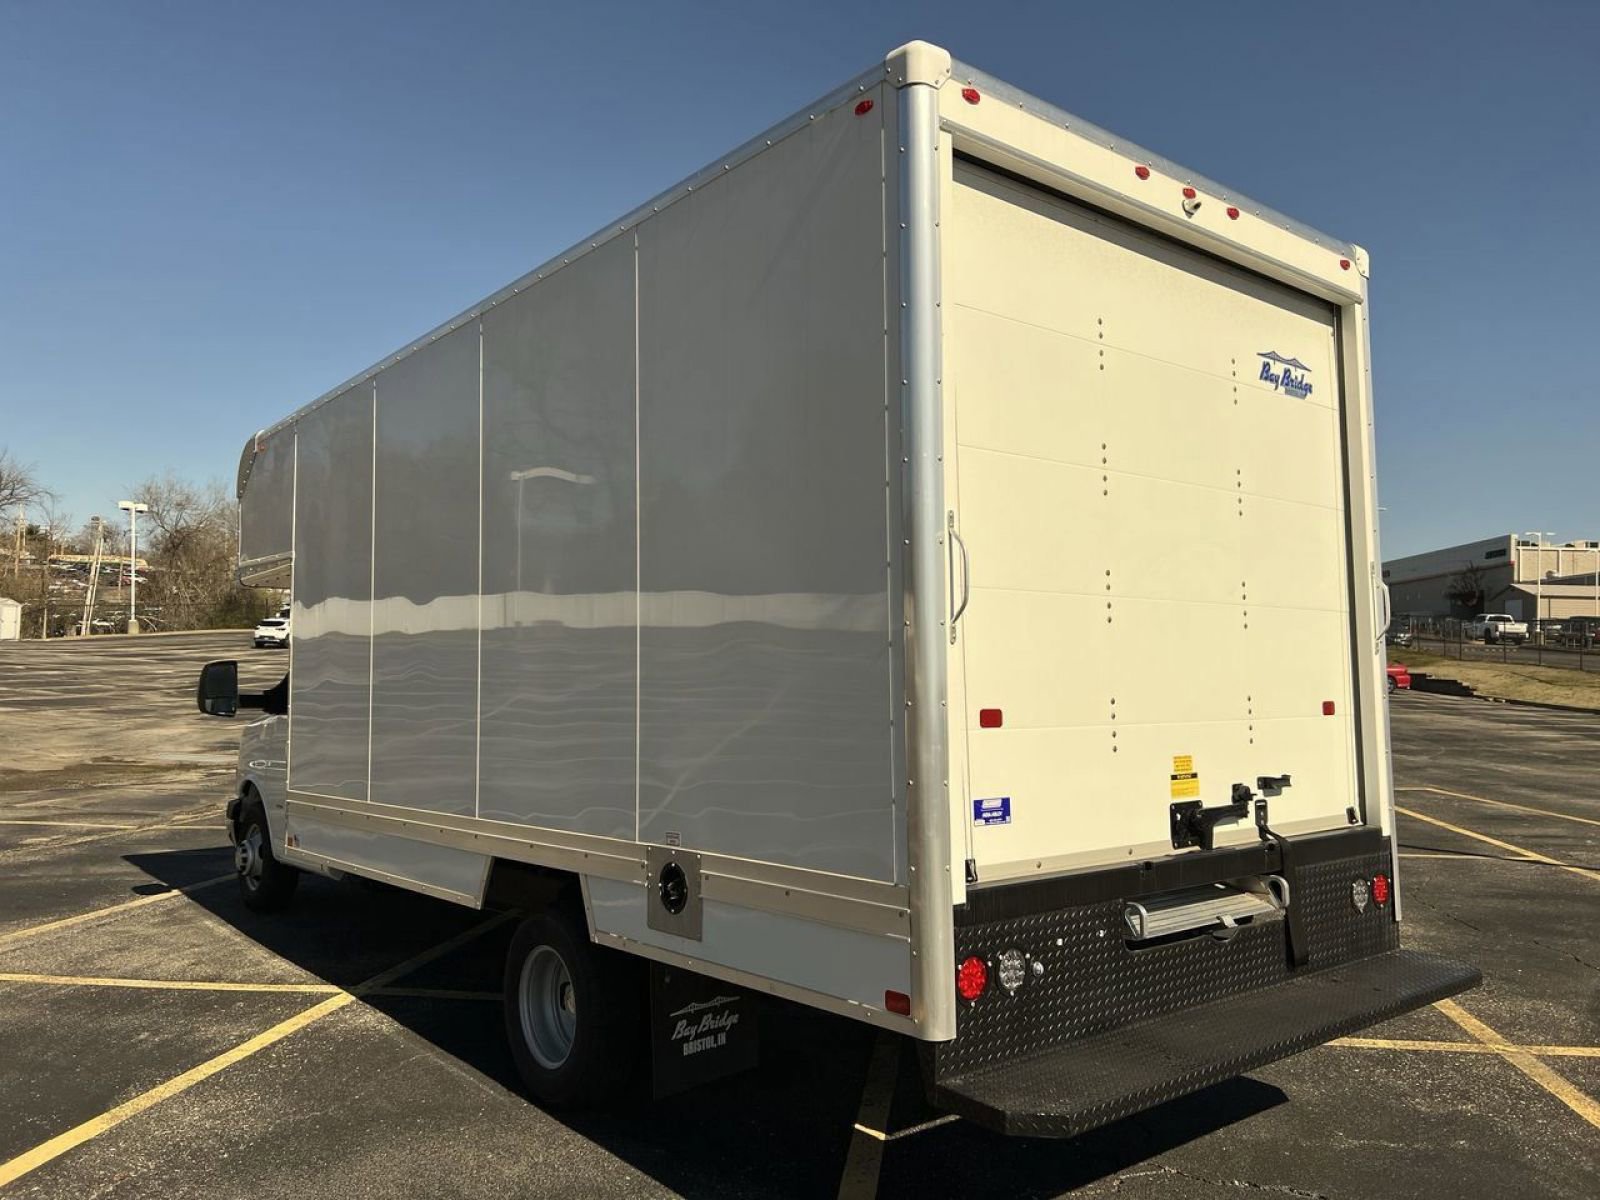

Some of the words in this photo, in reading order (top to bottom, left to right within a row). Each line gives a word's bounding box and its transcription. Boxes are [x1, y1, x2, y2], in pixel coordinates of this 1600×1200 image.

[1260, 360, 1280, 391] Bay
[1280, 367, 1313, 397] Bridge
[671, 1019, 698, 1041] Bay
[697, 1009, 739, 1033] Bridge
